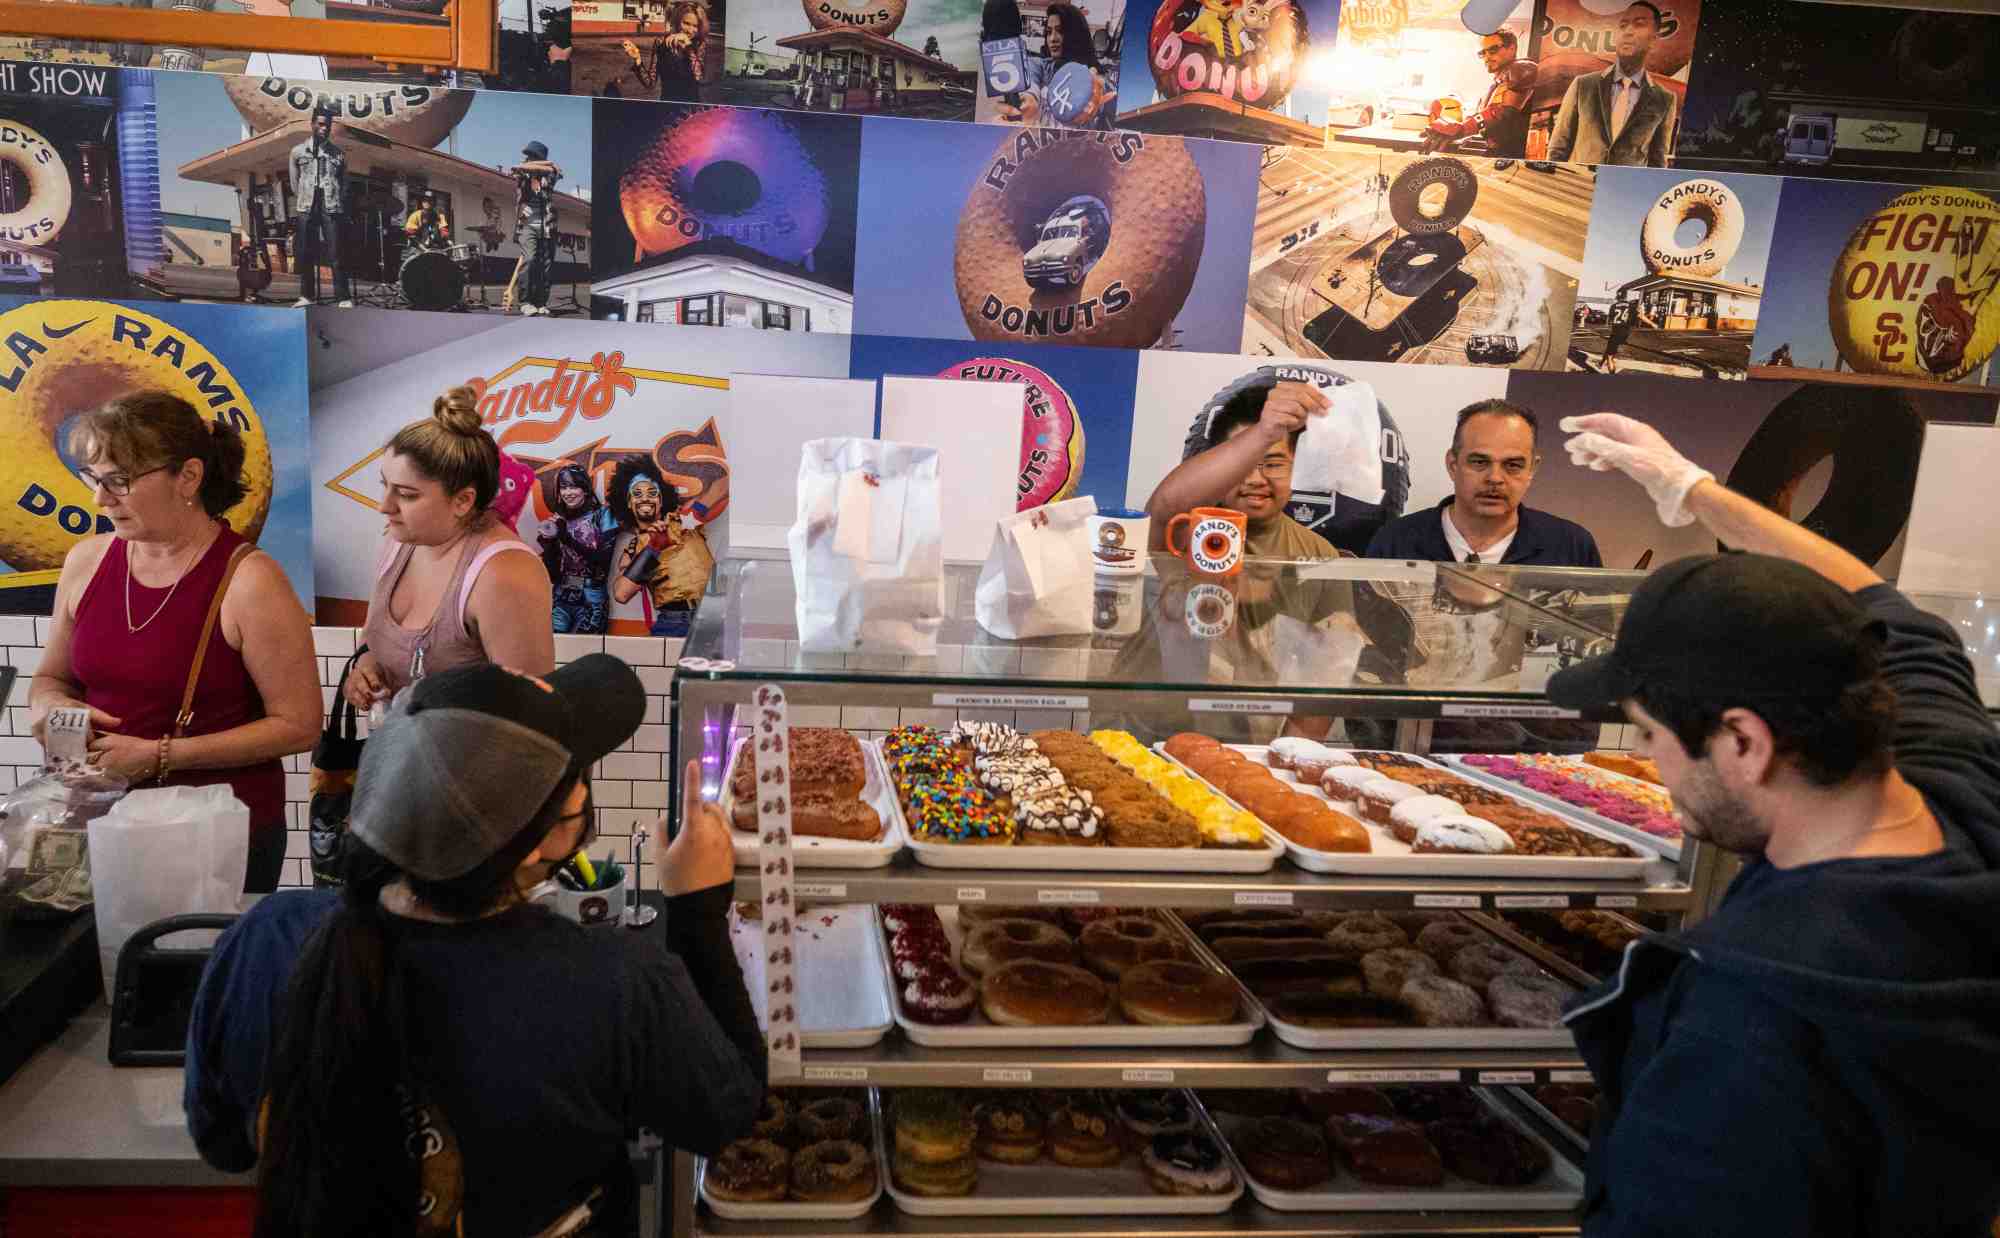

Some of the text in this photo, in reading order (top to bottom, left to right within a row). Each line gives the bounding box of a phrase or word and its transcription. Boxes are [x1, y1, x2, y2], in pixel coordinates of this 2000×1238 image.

[819, 2, 889, 24] DONUTS
[29, 65, 106, 96] SHOW
[990, 55, 1020, 93] 5
[1659, 183, 1728, 210] RANDY'S
[1857, 212, 1996, 255] FIGHT
[1652, 249, 1716, 266] DONUTS
[1845, 260, 1931, 302] ON!
[980, 279, 1133, 337] DONUTS
[0, 331, 48, 393] LA
[1194, 521, 1239, 539] RANDY'S
[1194, 552, 1238, 571] DONUTS
